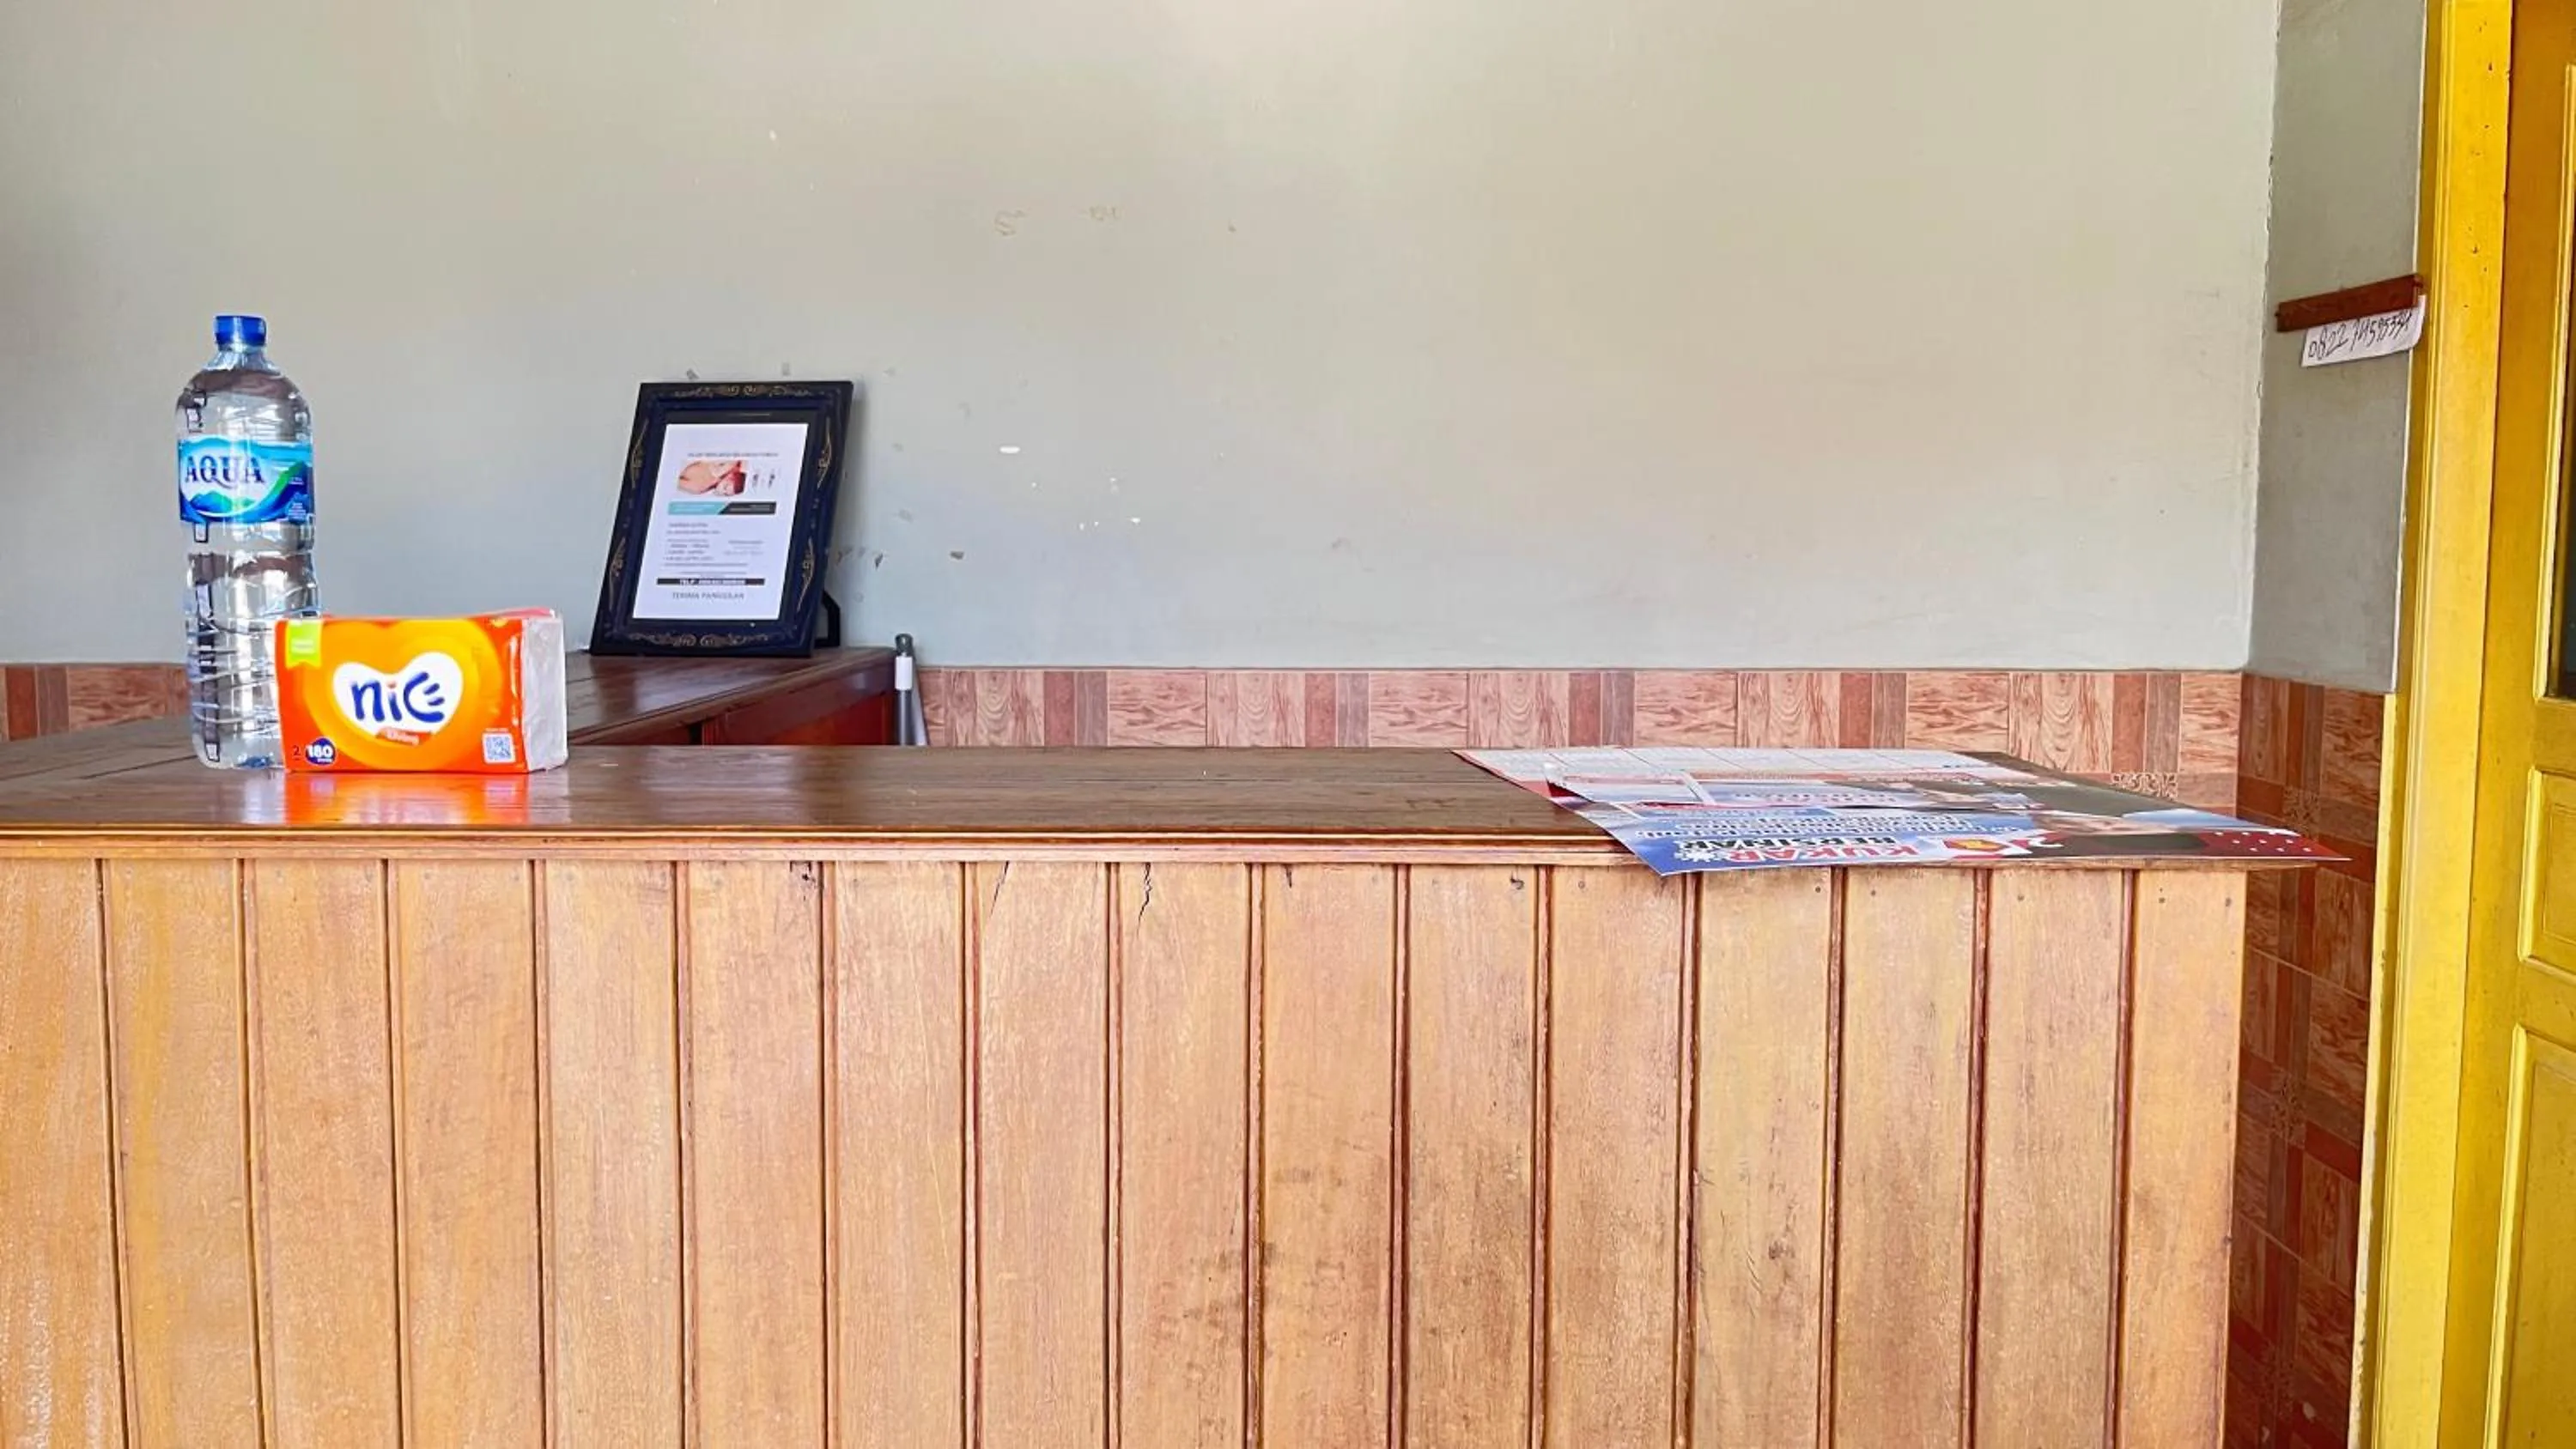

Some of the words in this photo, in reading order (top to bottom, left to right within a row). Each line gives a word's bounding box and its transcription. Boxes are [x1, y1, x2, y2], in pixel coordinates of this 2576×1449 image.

[185, 455, 264, 488] AQUA
[306, 744, 333, 758] 180
[1680, 836, 1895, 850] BERSINAR
[1728, 846, 1919, 862] KUKAR
